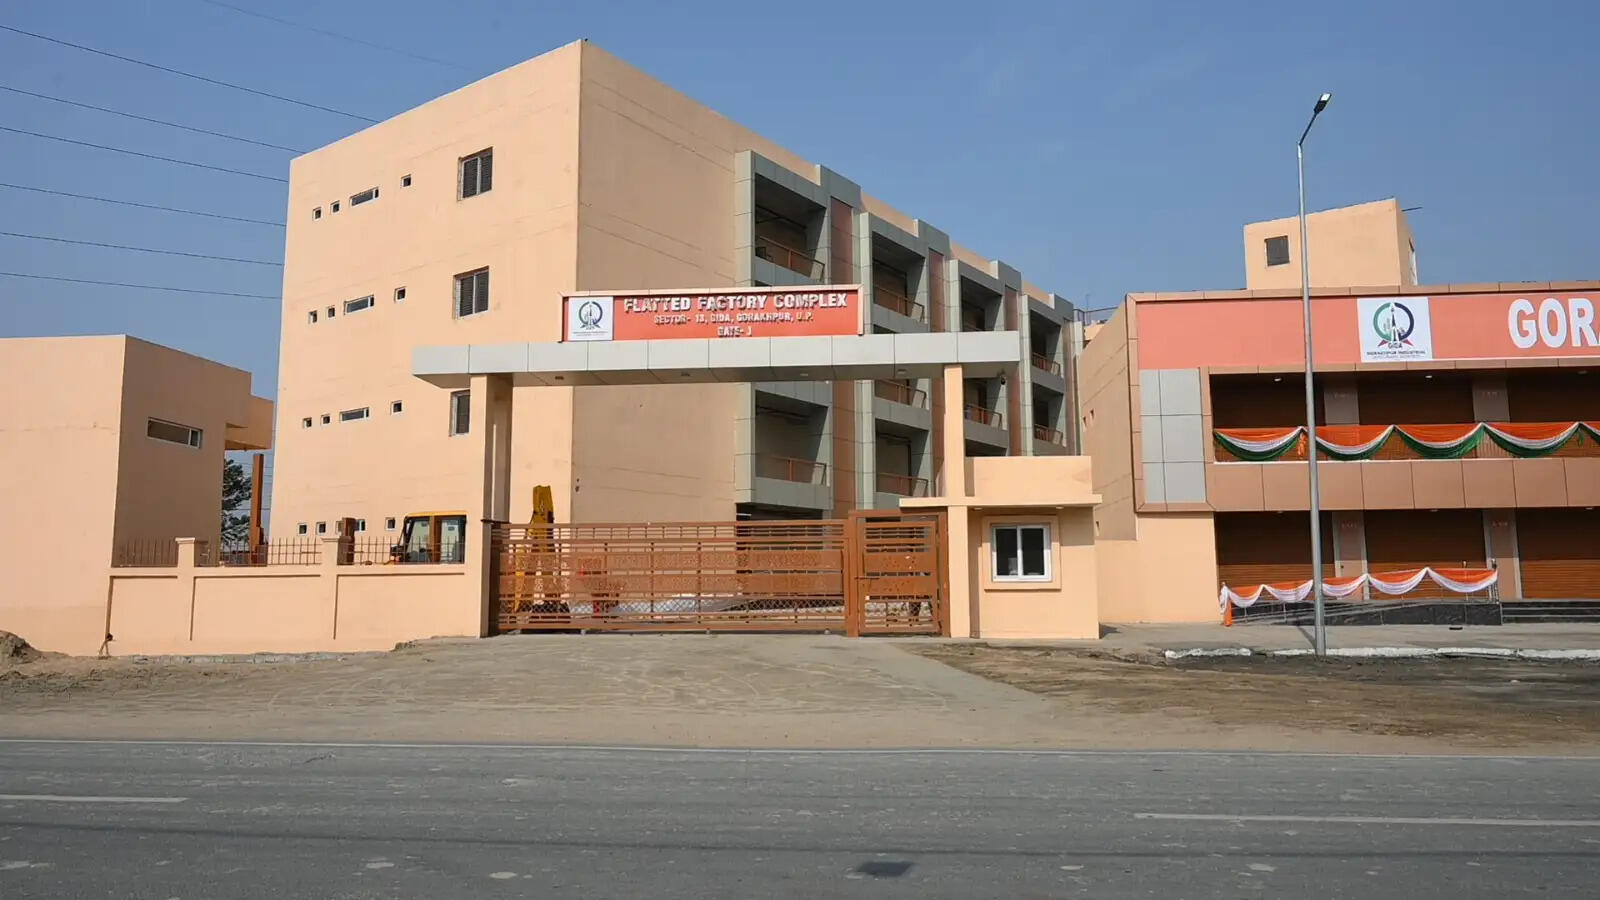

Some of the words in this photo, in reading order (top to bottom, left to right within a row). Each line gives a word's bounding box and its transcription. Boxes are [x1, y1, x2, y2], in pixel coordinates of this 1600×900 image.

[623, 298, 692, 313] FLATTED
[698, 296, 767, 311] FACTORY
[774, 293, 848, 309] COMPLEX
[1508, 298, 1600, 348] GOR
